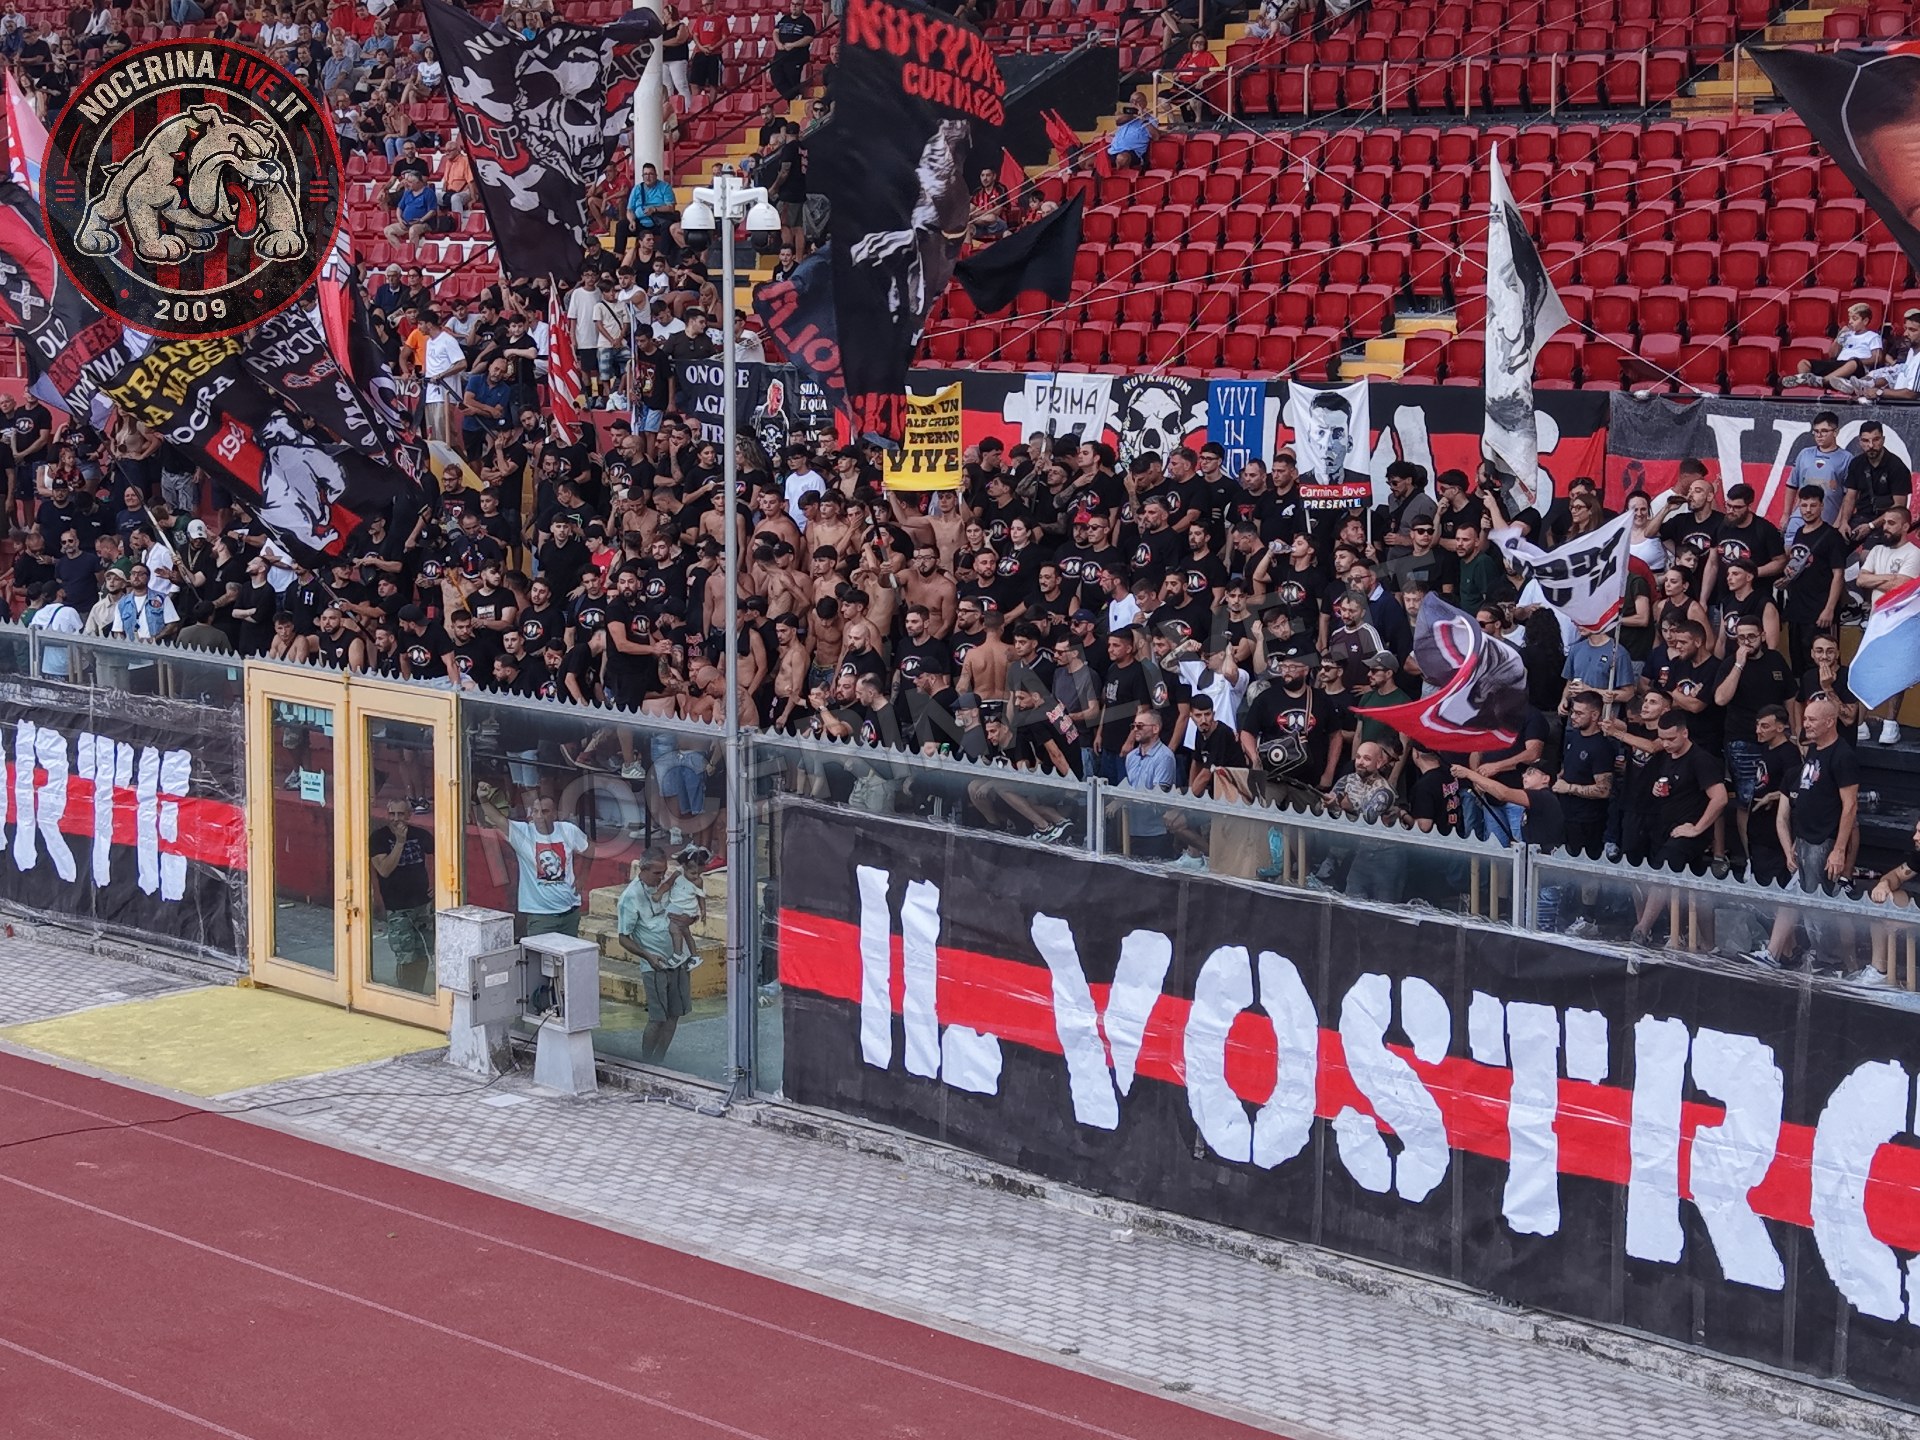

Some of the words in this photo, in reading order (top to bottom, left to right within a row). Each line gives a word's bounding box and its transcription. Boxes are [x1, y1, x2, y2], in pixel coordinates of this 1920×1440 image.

[162, 338, 241, 406] MASSA
[686, 365, 750, 388] ONOE
[800, 383, 824, 396] SILV
[1036, 386, 1098, 415] PRIMA
[1216, 386, 1258, 416] VIVI
[939, 399, 959, 413] UN
[906, 418, 928, 428] ALE
[928, 415, 960, 427] CREDE
[1224, 419, 1246, 446] IN
[909, 430, 960, 444] ETERNO
[887, 448, 960, 473] VIVE
[1299, 485, 1340, 498] Carmine
[1342, 485, 1367, 497] Bove
[1303, 498, 1362, 510] PRESENTE
[0, 718, 193, 900] RTE
[855, 863, 1003, 1096] IL
